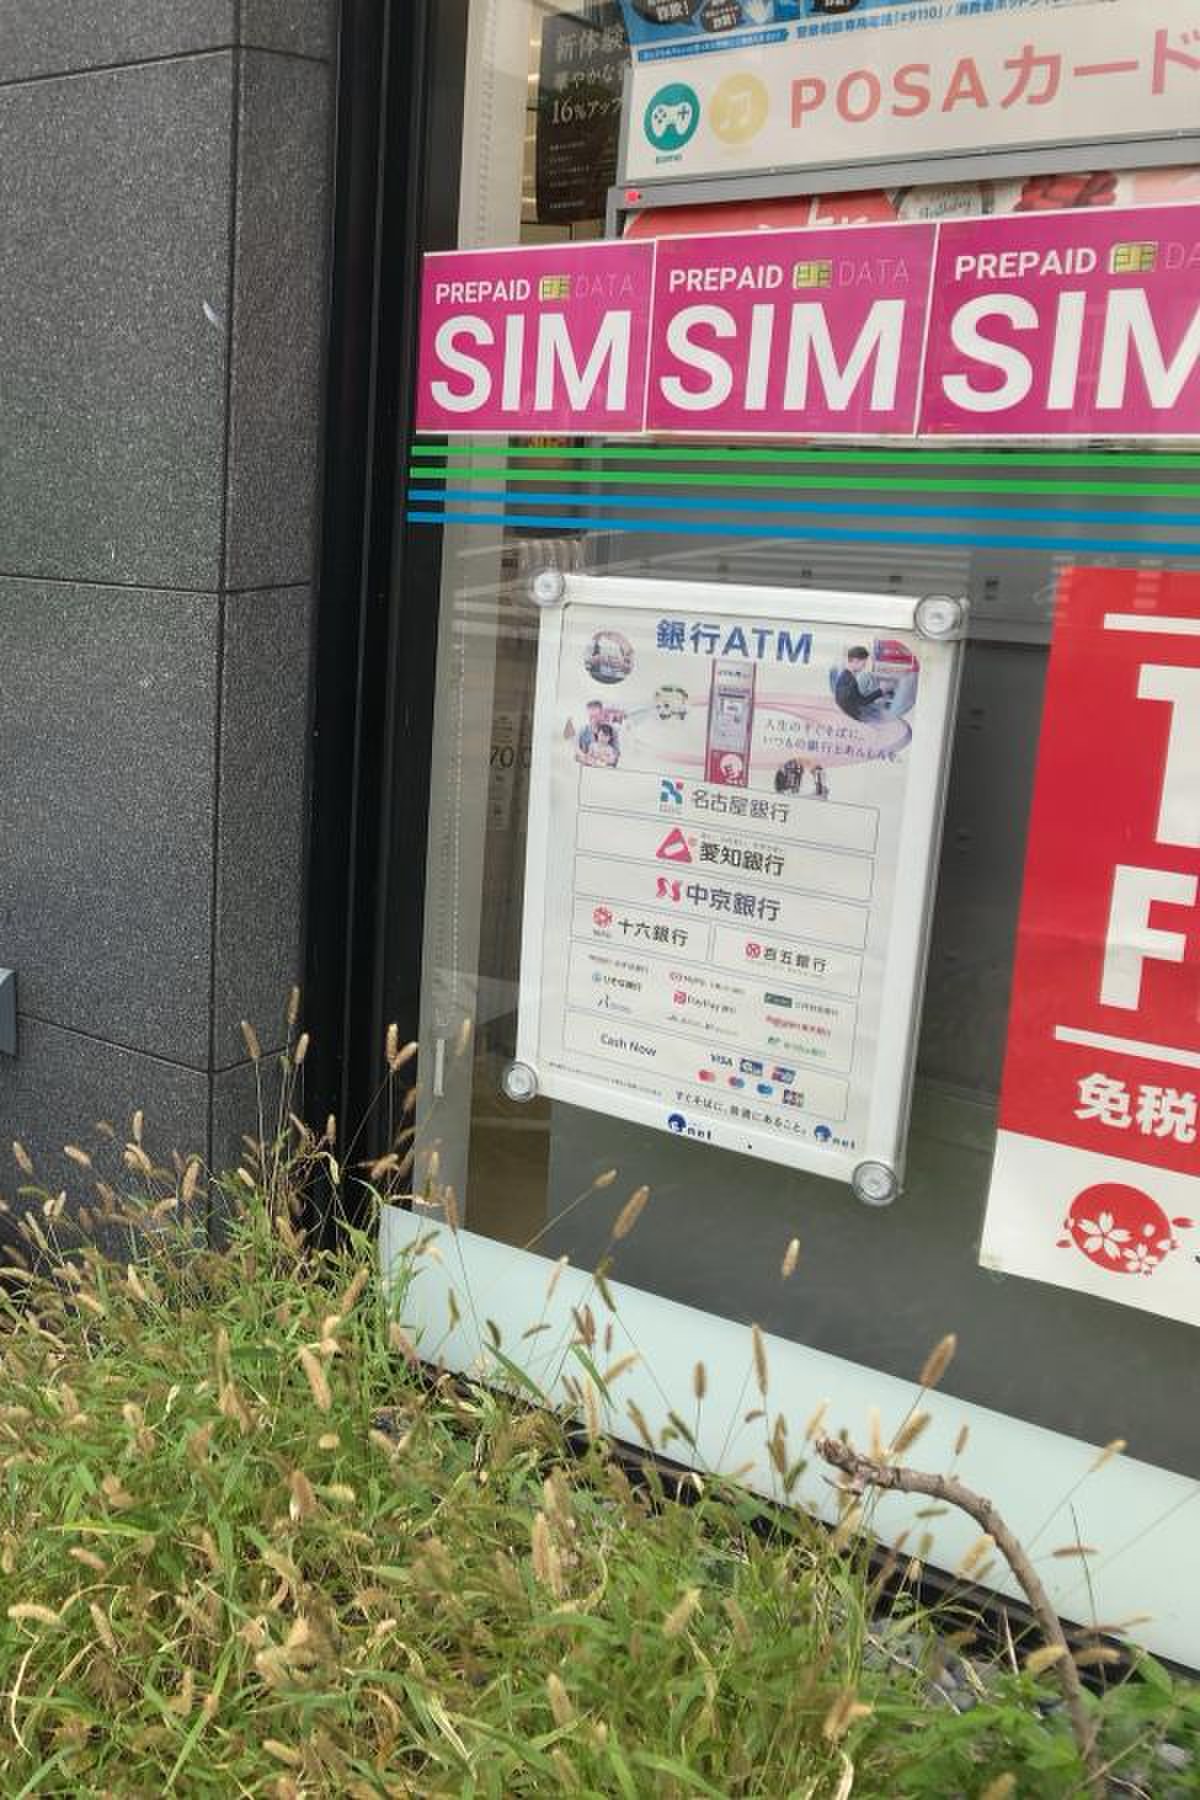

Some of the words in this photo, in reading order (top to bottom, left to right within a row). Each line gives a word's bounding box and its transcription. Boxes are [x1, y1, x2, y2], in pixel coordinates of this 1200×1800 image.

[790, 28, 1200, 129] POSAカード
[669, 265, 783, 293] PREPAID
[840, 258, 909, 288] DATA
[955, 247, 1097, 281] PREPAID
[435, 279, 531, 305] PREPAID
[575, 275, 634, 299] DATA
[431, 311, 631, 414] SIM
[659, 300, 906, 413] SIM
[656, 618, 813, 665] 銀行ATM
[692, 788, 791, 823] 名古屋銀行
[699, 841, 785, 877] 愛知銀行
[685, 886, 781, 923] 中京銀行
[617, 916, 689, 947] 十六銀行
[763, 945, 827, 974] 百五銀行
[600, 1032, 628, 1053] Cash
[630, 1038, 657, 1058] Now
[1074, 1072, 1198, 1144] 免税
